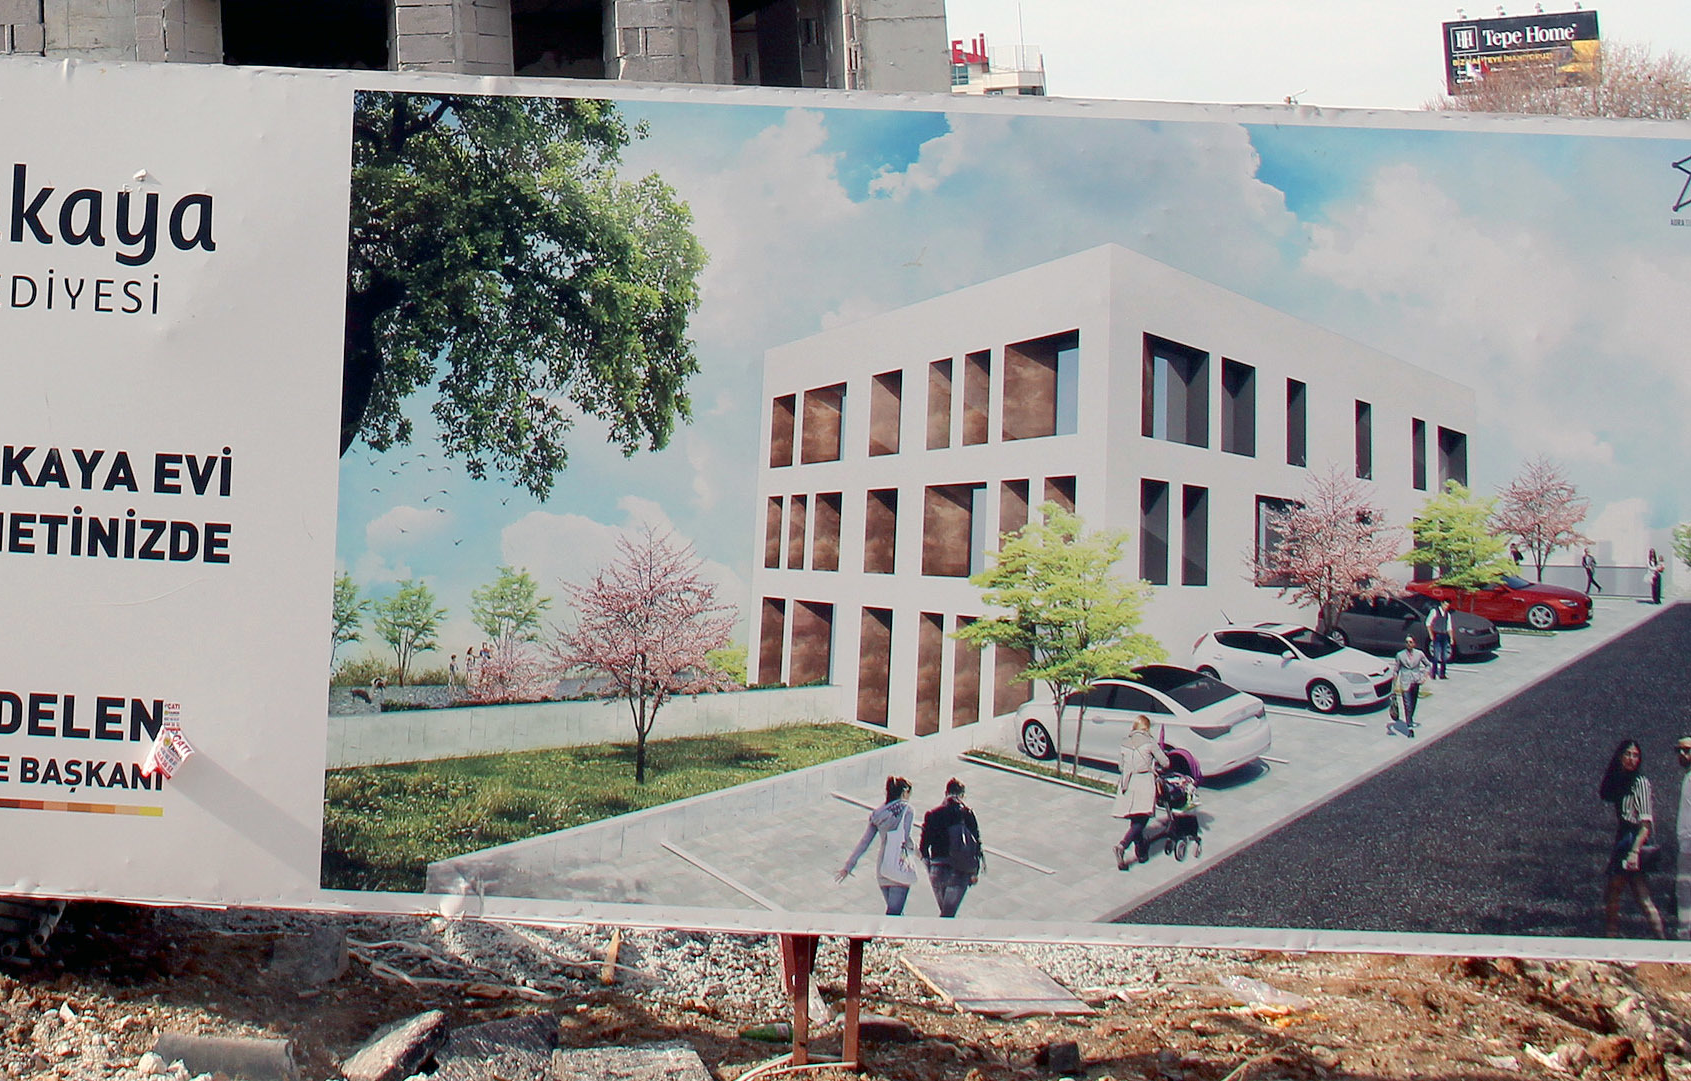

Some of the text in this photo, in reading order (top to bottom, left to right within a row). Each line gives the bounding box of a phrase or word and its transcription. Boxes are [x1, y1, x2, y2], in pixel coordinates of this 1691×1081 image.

[1482, 25, 1574, 48] Tepe Home
[153, 446, 233, 497] EVİ
[19, 756, 164, 793] BAŞKANI
